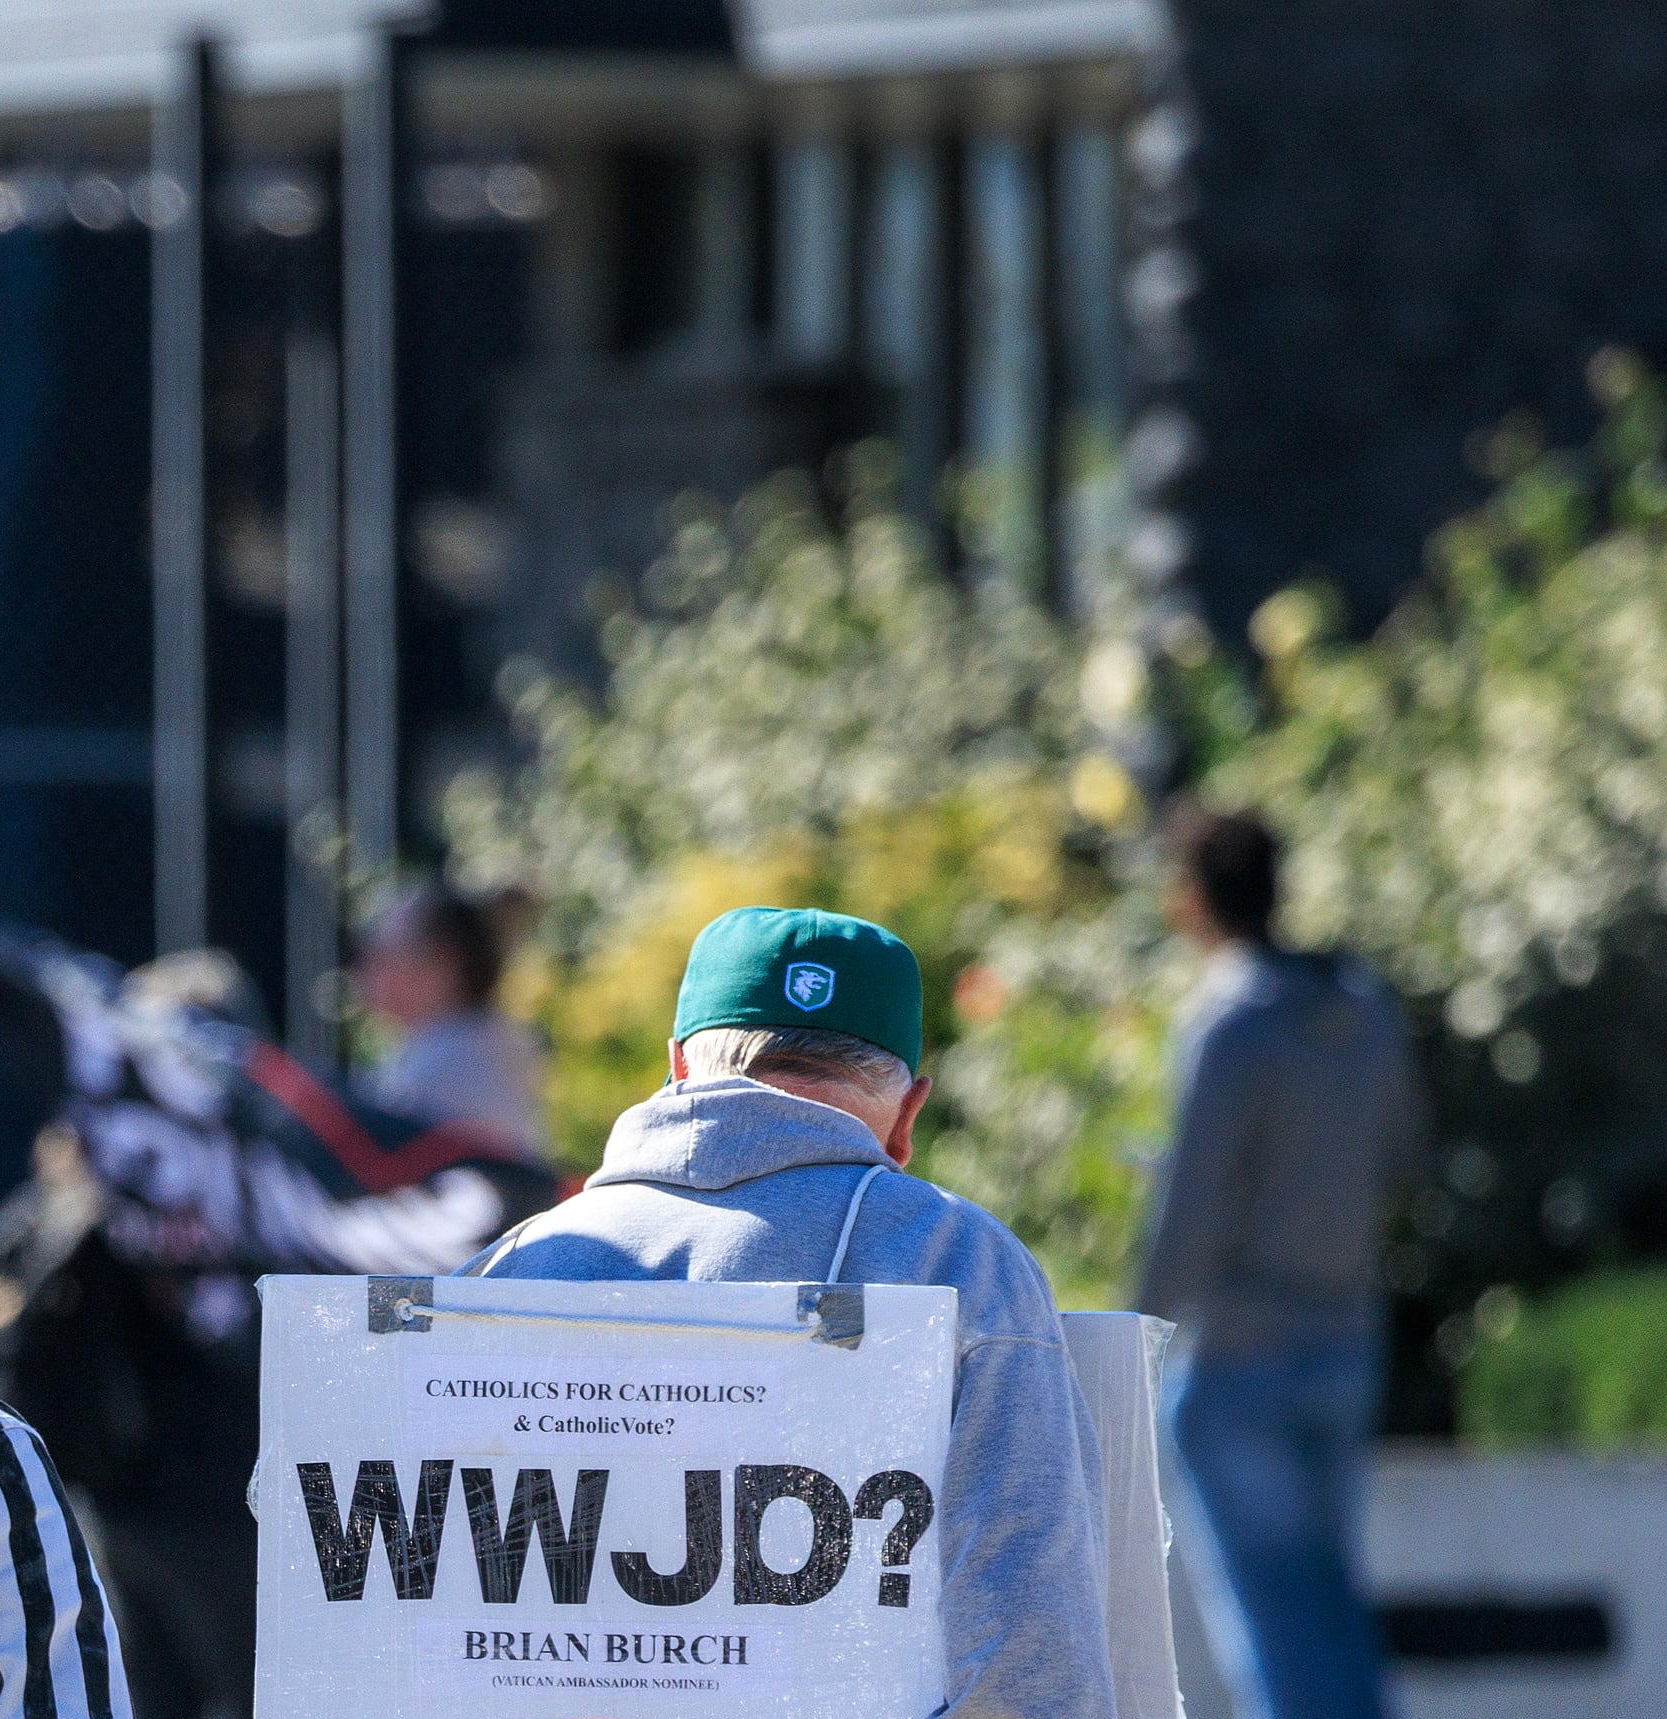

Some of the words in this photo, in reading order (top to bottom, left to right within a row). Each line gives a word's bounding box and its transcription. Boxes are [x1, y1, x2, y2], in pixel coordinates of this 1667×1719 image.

[425, 1378, 559, 1400] CATHOLICS
[566, 1382, 614, 1402] FOR
[618, 1383, 767, 1404] CATHOLICS?
[513, 1414, 531, 1433] &
[537, 1414, 676, 1436] CatholicVote?
[295, 1459, 936, 1609] WWJD?
[463, 1630, 592, 1663] BRIAN
[603, 1633, 751, 1666] BURCH
[492, 1675, 554, 1689] (VATICAN
[556, 1676, 649, 1690] AMBASSADOR
[651, 1678, 720, 1692] NOMINEE)
